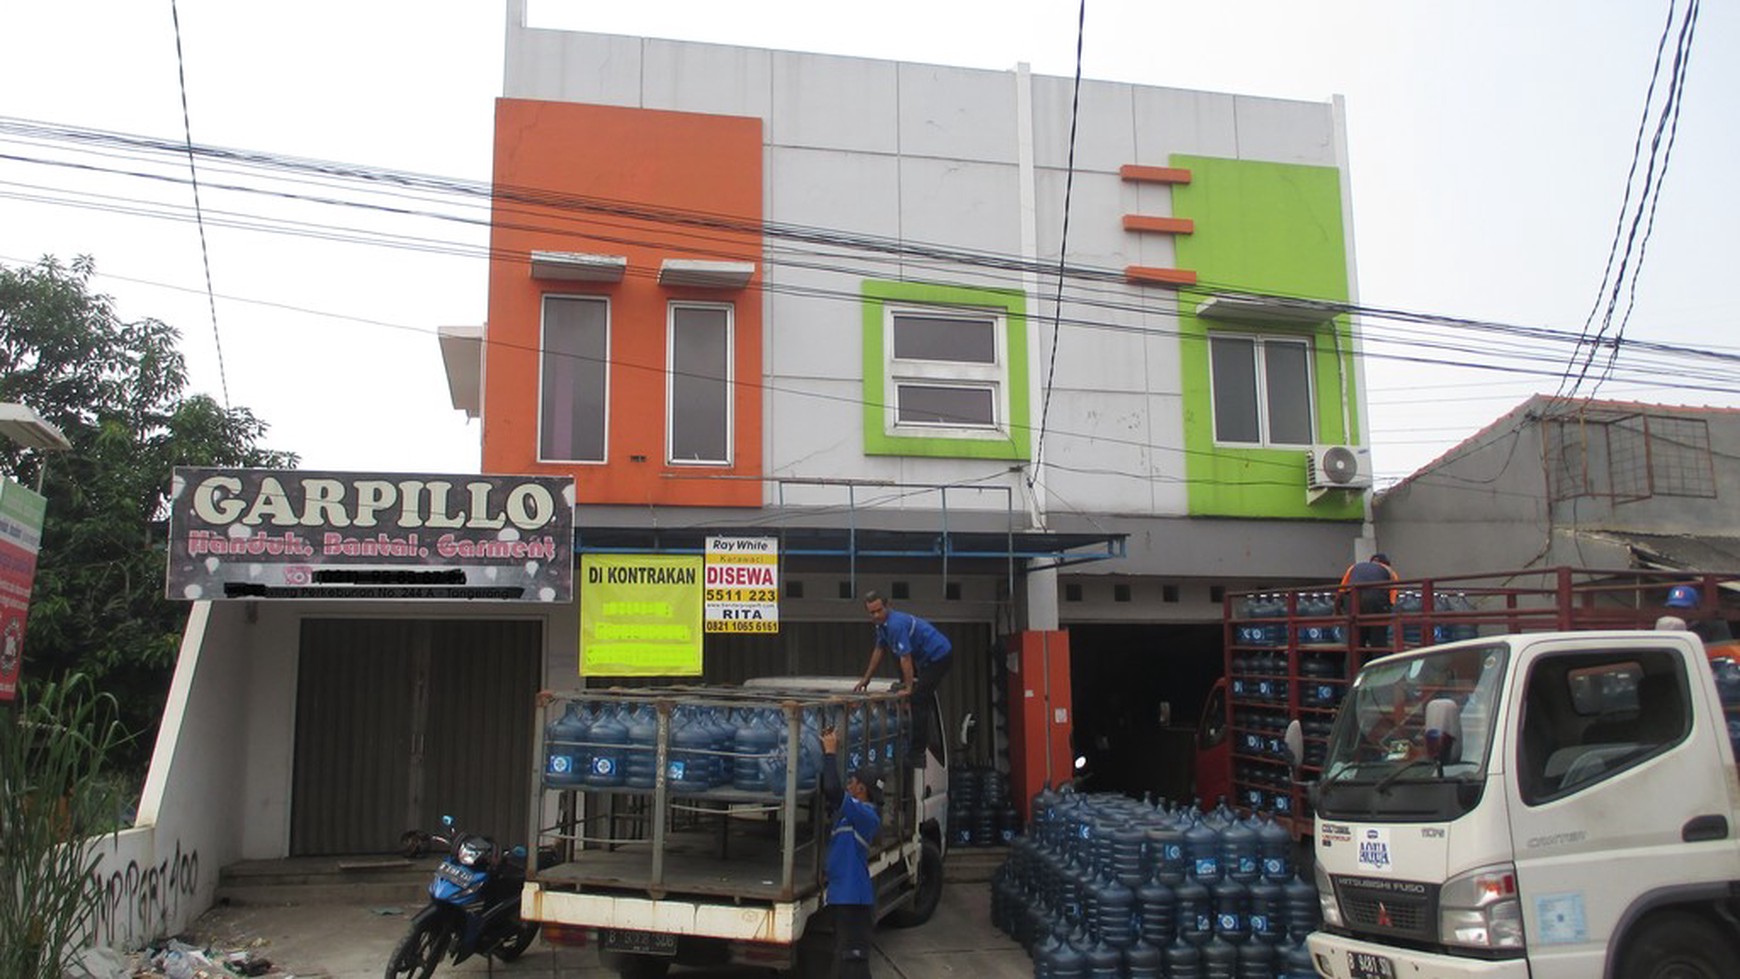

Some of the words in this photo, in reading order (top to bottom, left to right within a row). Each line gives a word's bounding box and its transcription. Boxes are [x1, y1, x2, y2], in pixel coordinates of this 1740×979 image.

[193, 476, 555, 530] GARPILLO
[437, 533, 556, 560] Garment
[713, 540, 735, 551] Ray
[736, 540, 768, 551] White
[588, 566, 603, 584] DI
[607, 567, 696, 585] KONTRAKAN
[706, 566, 774, 586] DISEWA
[706, 589, 742, 601] 5511
[749, 589, 776, 602] 223
[723, 609, 763, 619] RITA
[1394, 884, 1425, 893] FUSO
